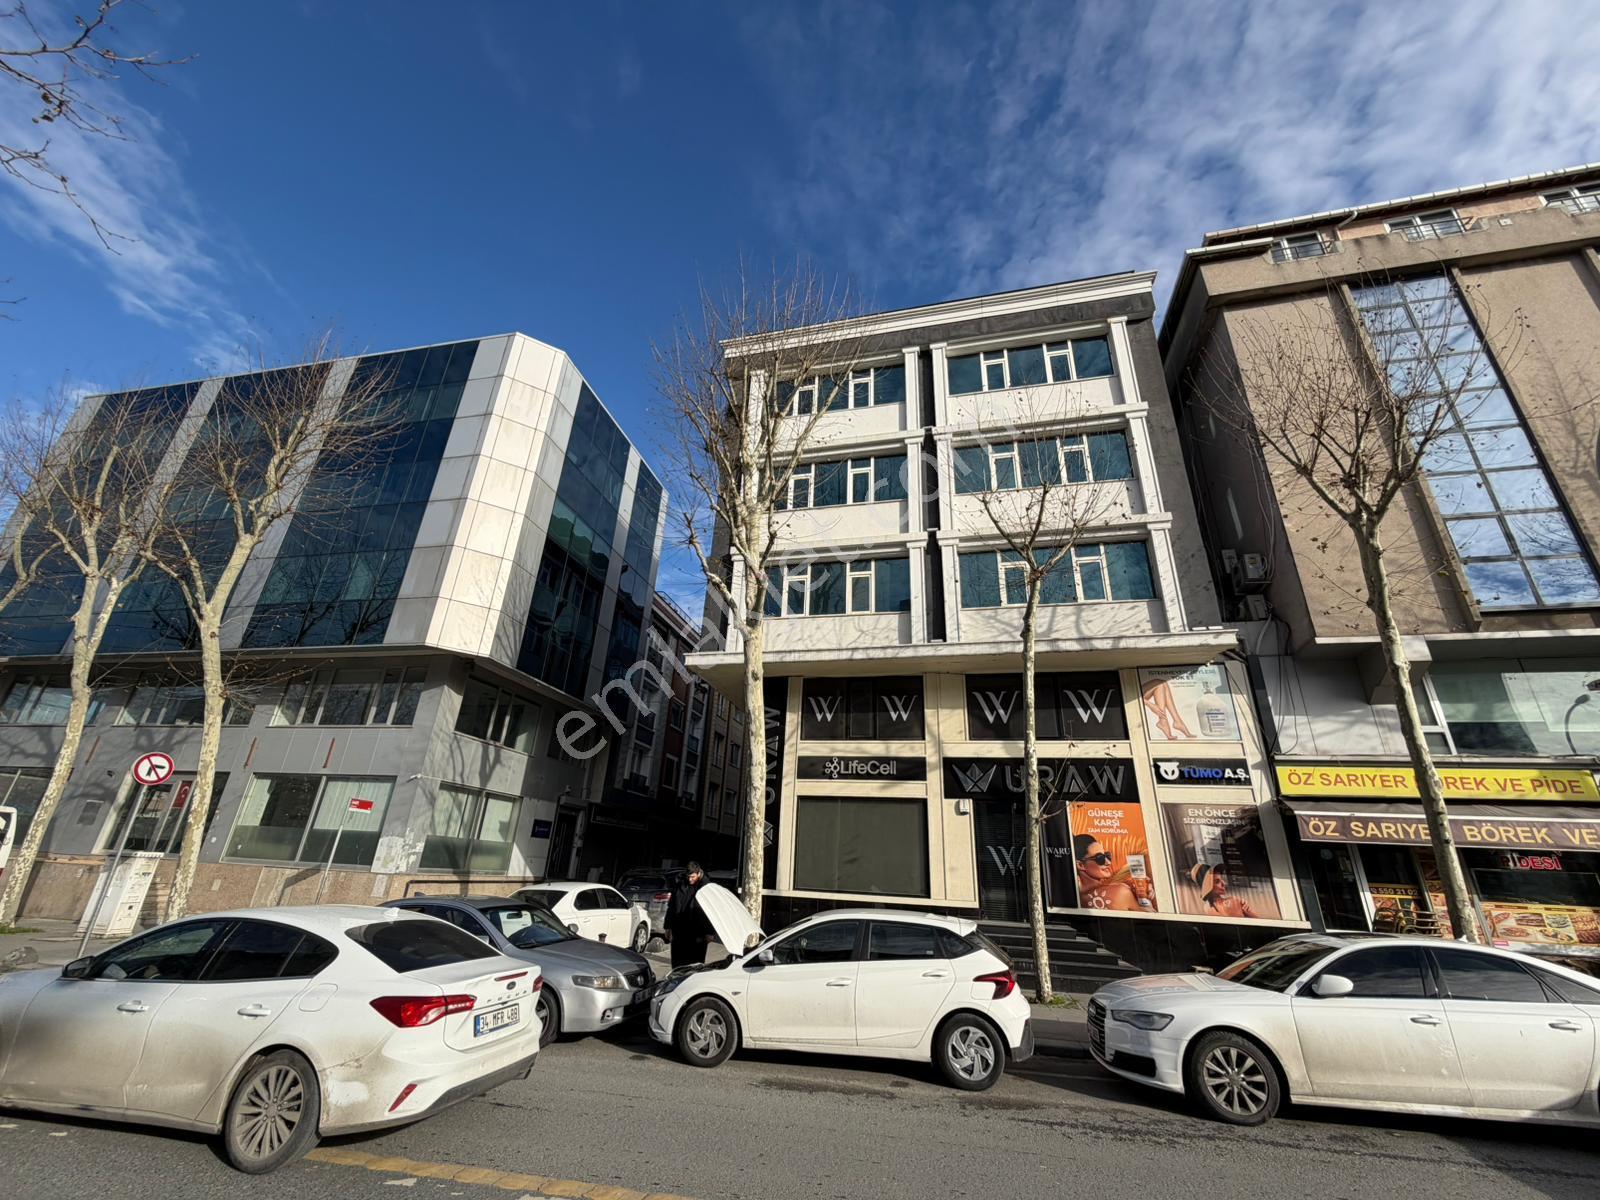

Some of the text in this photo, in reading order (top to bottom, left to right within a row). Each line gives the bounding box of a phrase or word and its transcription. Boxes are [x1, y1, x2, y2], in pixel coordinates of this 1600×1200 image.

[840, 759, 897, 775] LifeCell
[1004, 764, 1125, 794] URAW
[1287, 769, 1585, 795] ÖZ SARIYER REK VE PİDE
[1188, 807, 1236, 818] EN ÖNCE
[1308, 817, 1600, 845] ÖZ SARIYE BÖREK VE
[480, 1016, 489, 1030] 34
[492, 1011, 504, 1026] MFR
